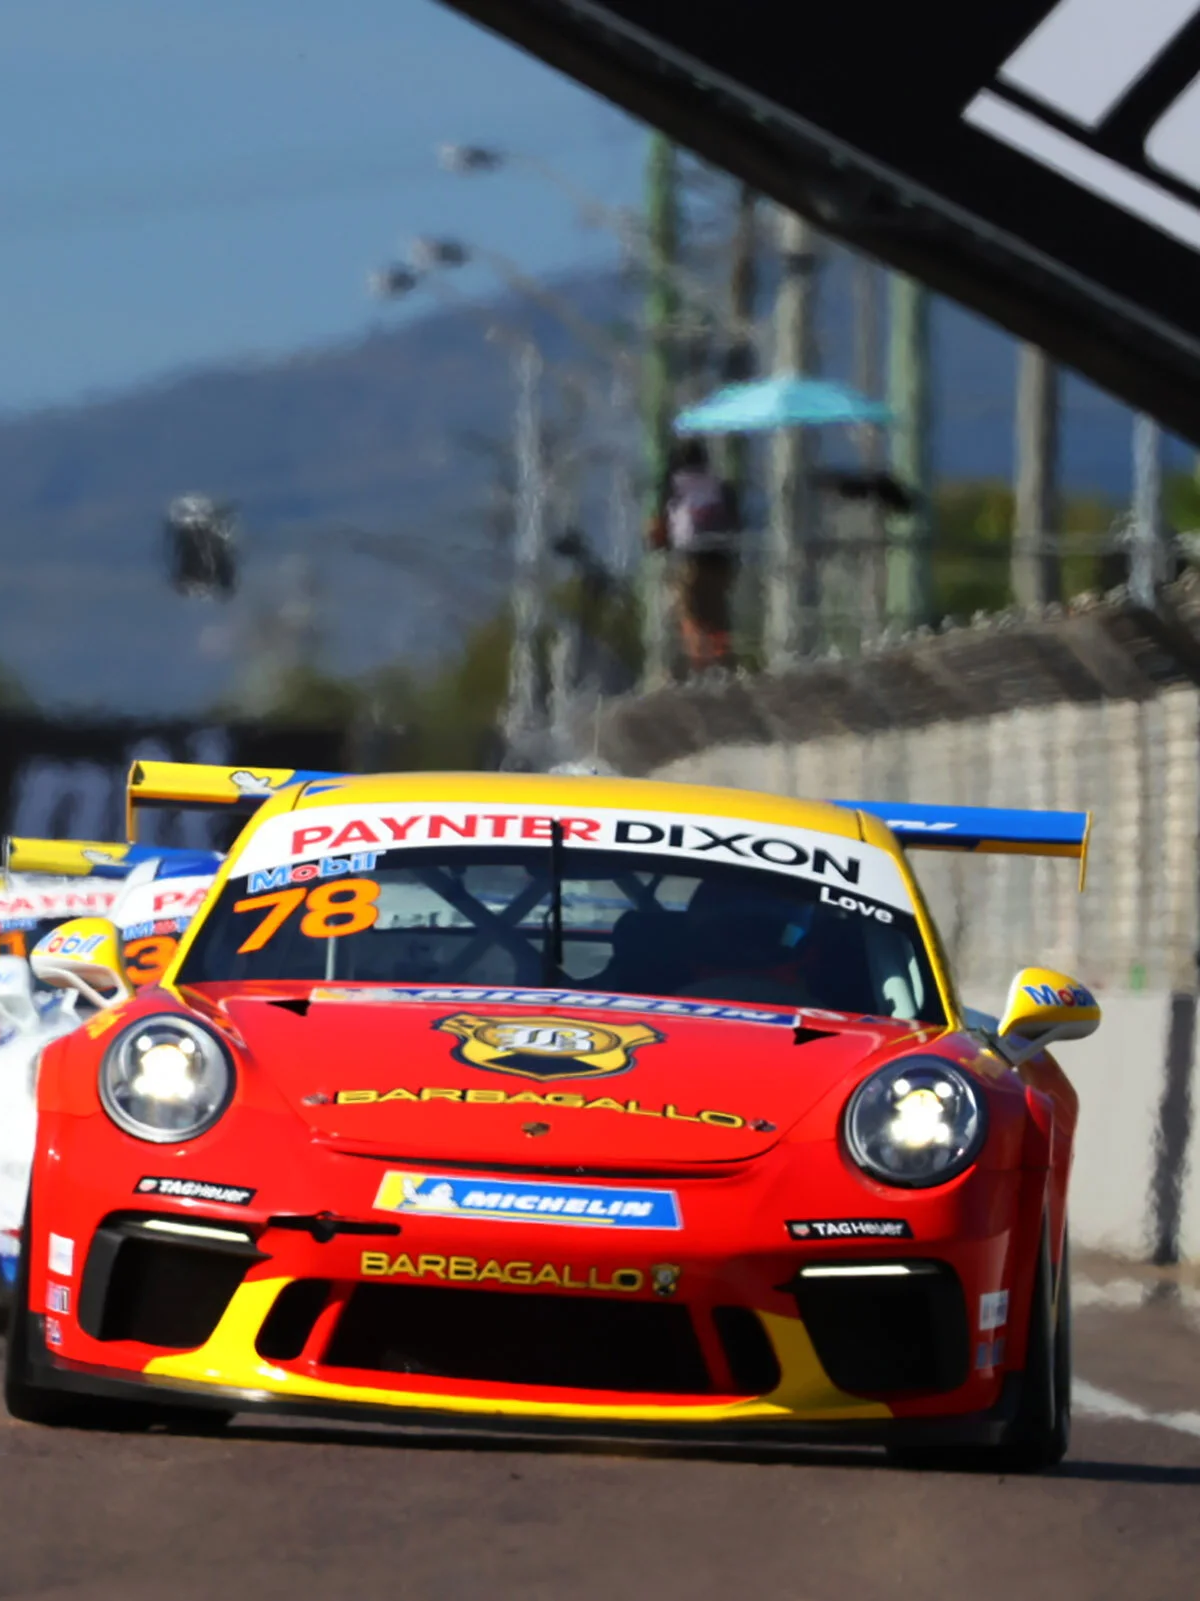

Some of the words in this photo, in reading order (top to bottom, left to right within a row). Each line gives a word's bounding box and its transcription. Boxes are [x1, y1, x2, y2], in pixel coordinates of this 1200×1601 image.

[290, 814, 601, 855] PAYNTER
[614, 820, 861, 885] DIXON
[246, 851, 378, 894] Mobil
[233, 878, 381, 954] 78
[820, 886, 894, 924] Love
[336, 1088, 747, 1129] BARBAGALLO
[461, 1190, 654, 1218] MICHELIN
[361, 1250, 644, 1292] BARBAGALLO
